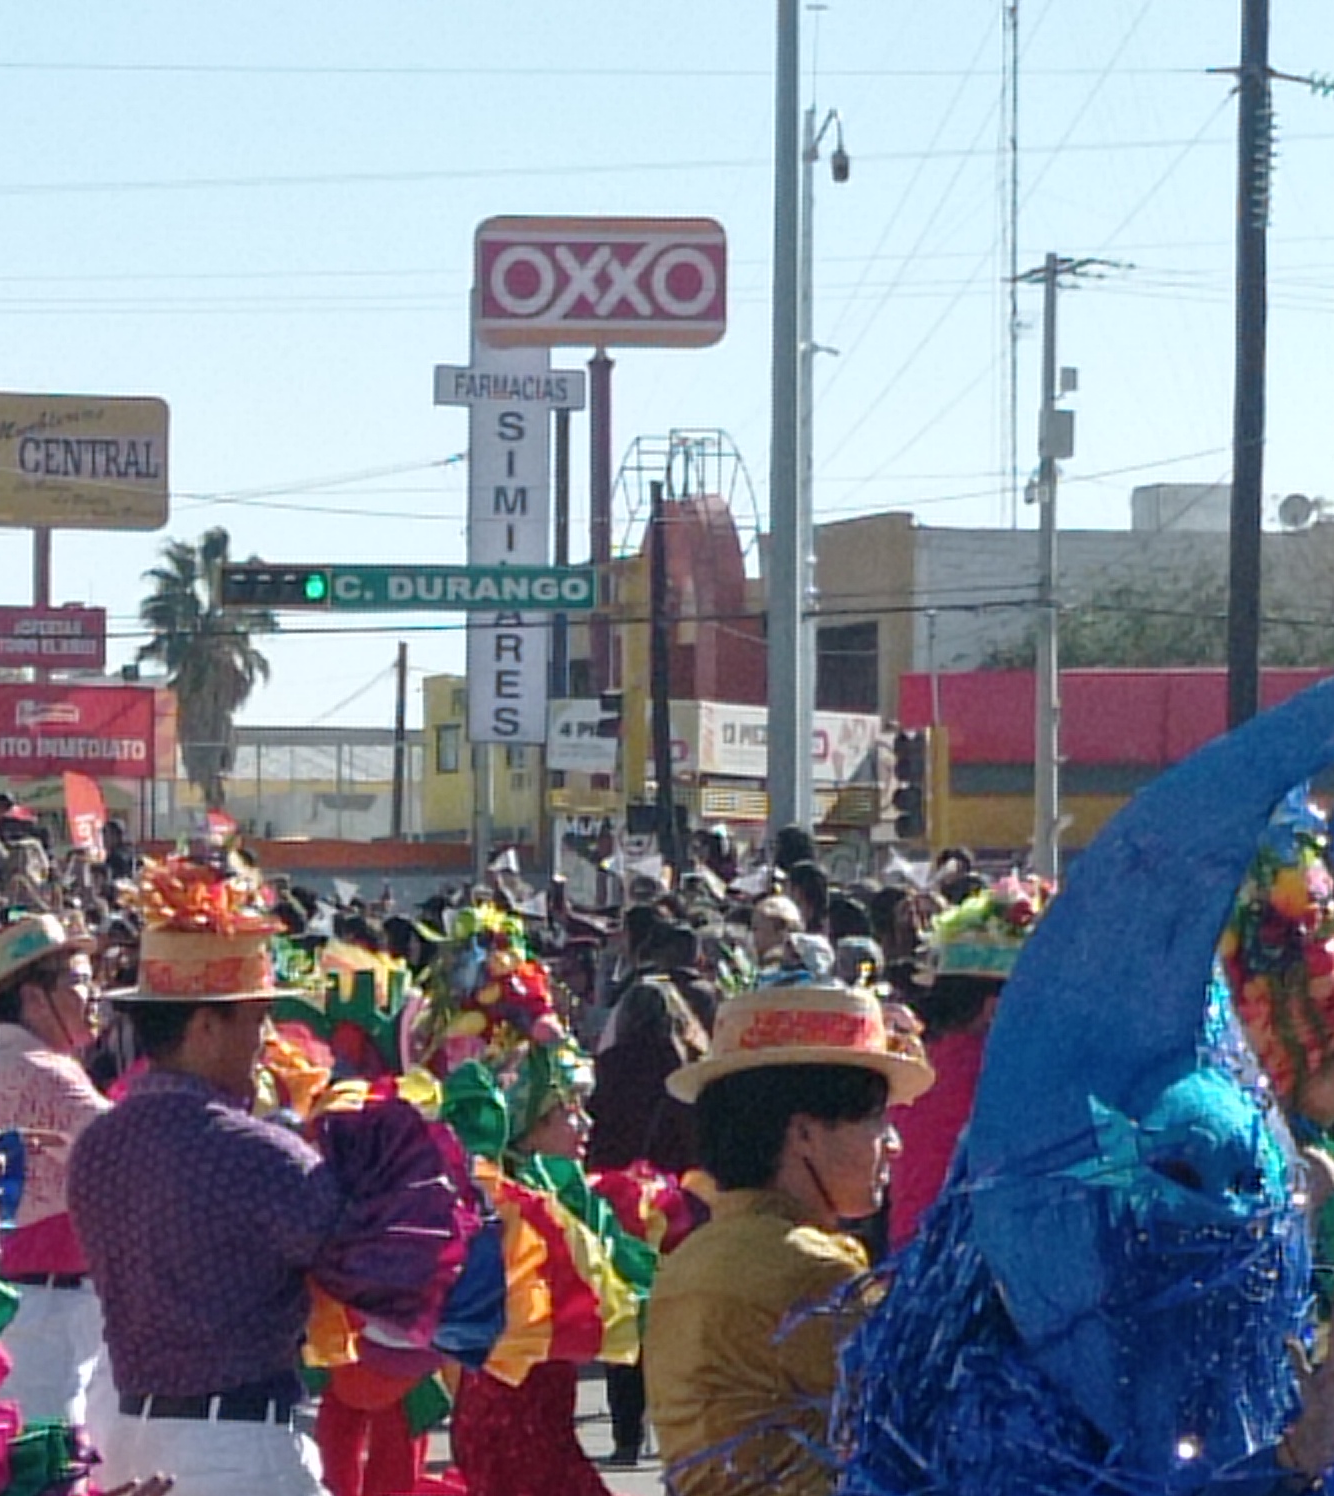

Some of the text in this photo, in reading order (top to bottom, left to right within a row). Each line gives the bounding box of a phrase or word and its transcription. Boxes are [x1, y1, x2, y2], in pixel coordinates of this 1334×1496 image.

[490, 243, 717, 318] OXXO
[453, 371, 569, 401] FARMACIAS
[19, 437, 158, 478] CENTRAL
[334, 575, 590, 601] C. DURANGO
[491, 410, 529, 737] SIMIARES
